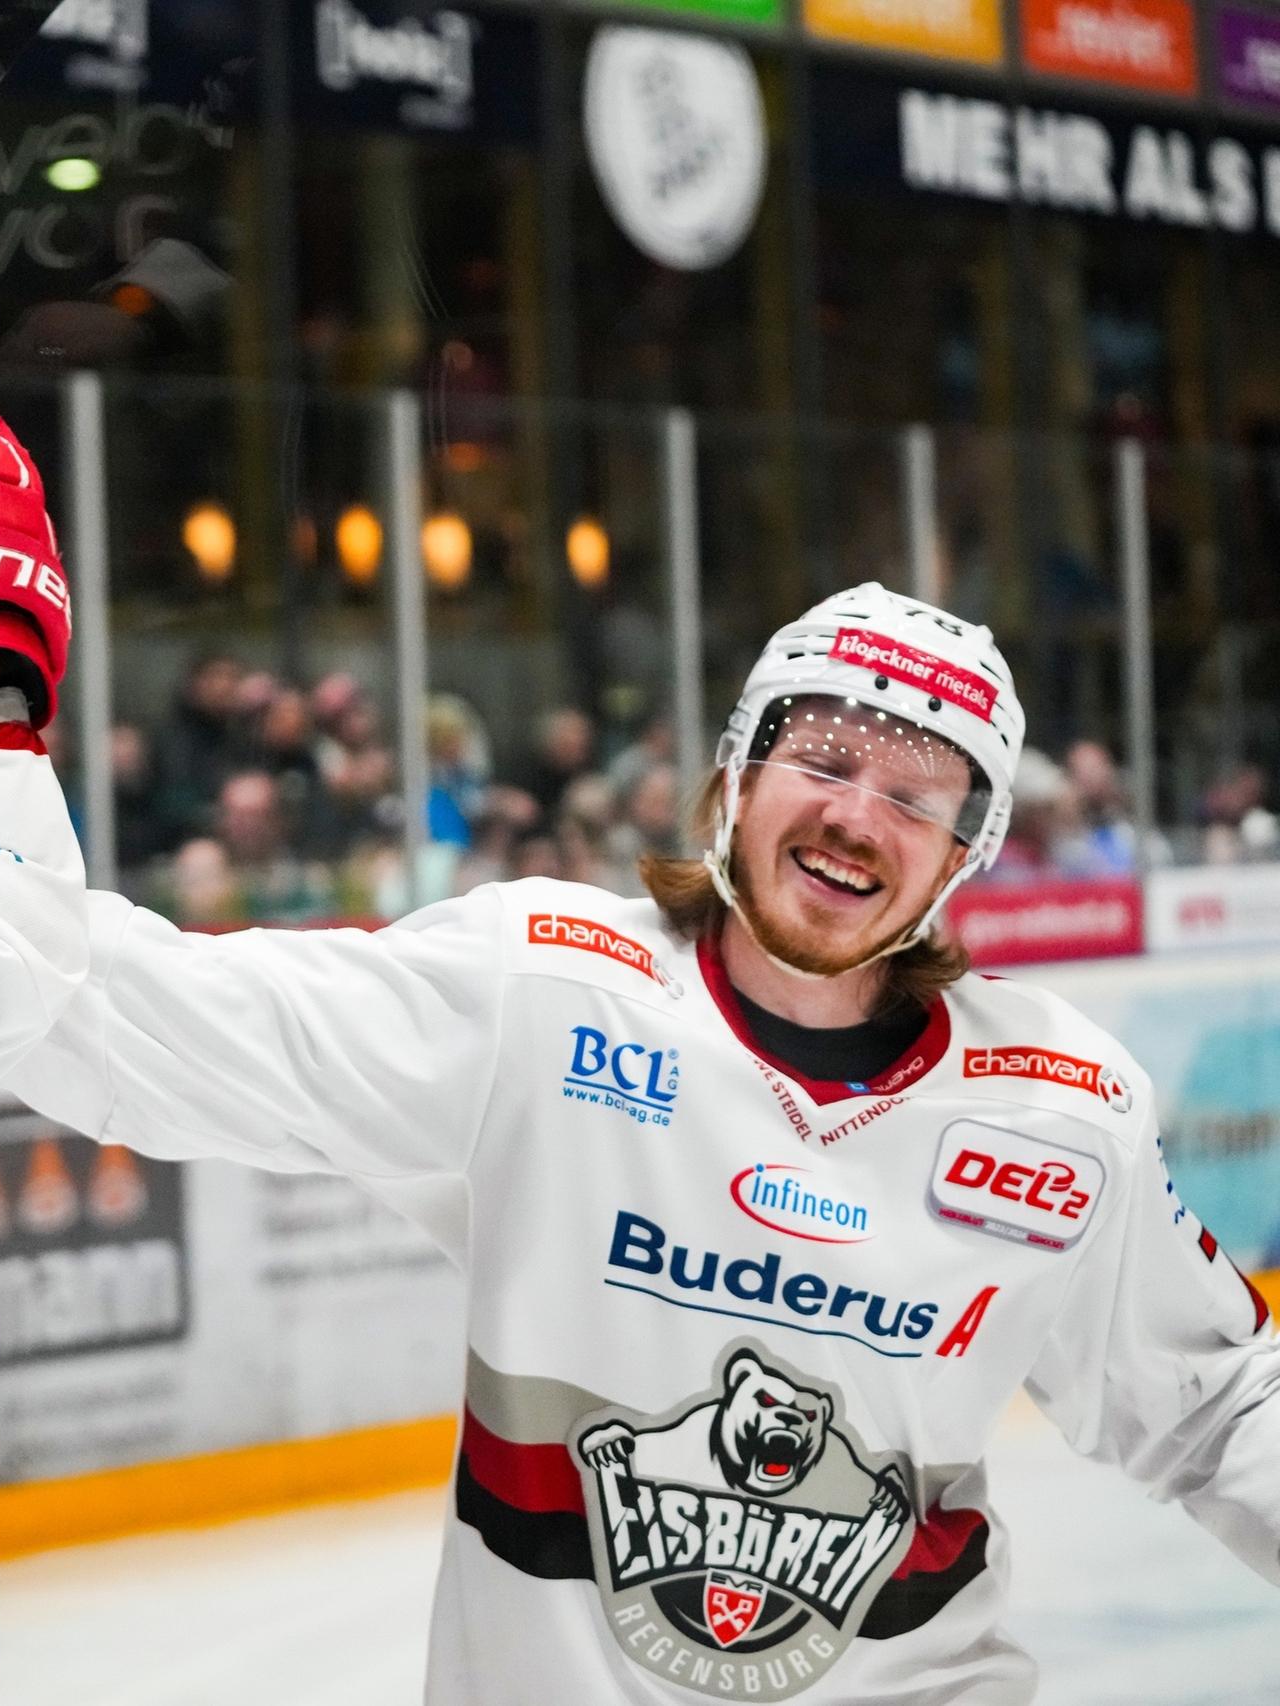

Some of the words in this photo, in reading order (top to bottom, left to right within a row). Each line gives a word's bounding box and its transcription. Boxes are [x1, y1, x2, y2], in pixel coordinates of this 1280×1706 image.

[900, 88, 1116, 215] MEHR
[1125, 124, 1257, 233] ALS
[838, 635, 935, 681] kloeckner
[935, 671, 989, 711] metals
[533, 914, 649, 969] charivari
[570, 1025, 677, 1102] BCL
[967, 1047, 1095, 1087] charivari
[772, 1081, 813, 1142] STEIDEL
[751, 1163, 867, 1231] infineon
[608, 1210, 938, 1340] Buderus
[600, 1461, 901, 1611] EISBÄREN
[614, 1602, 835, 1694] REGENSBURG
